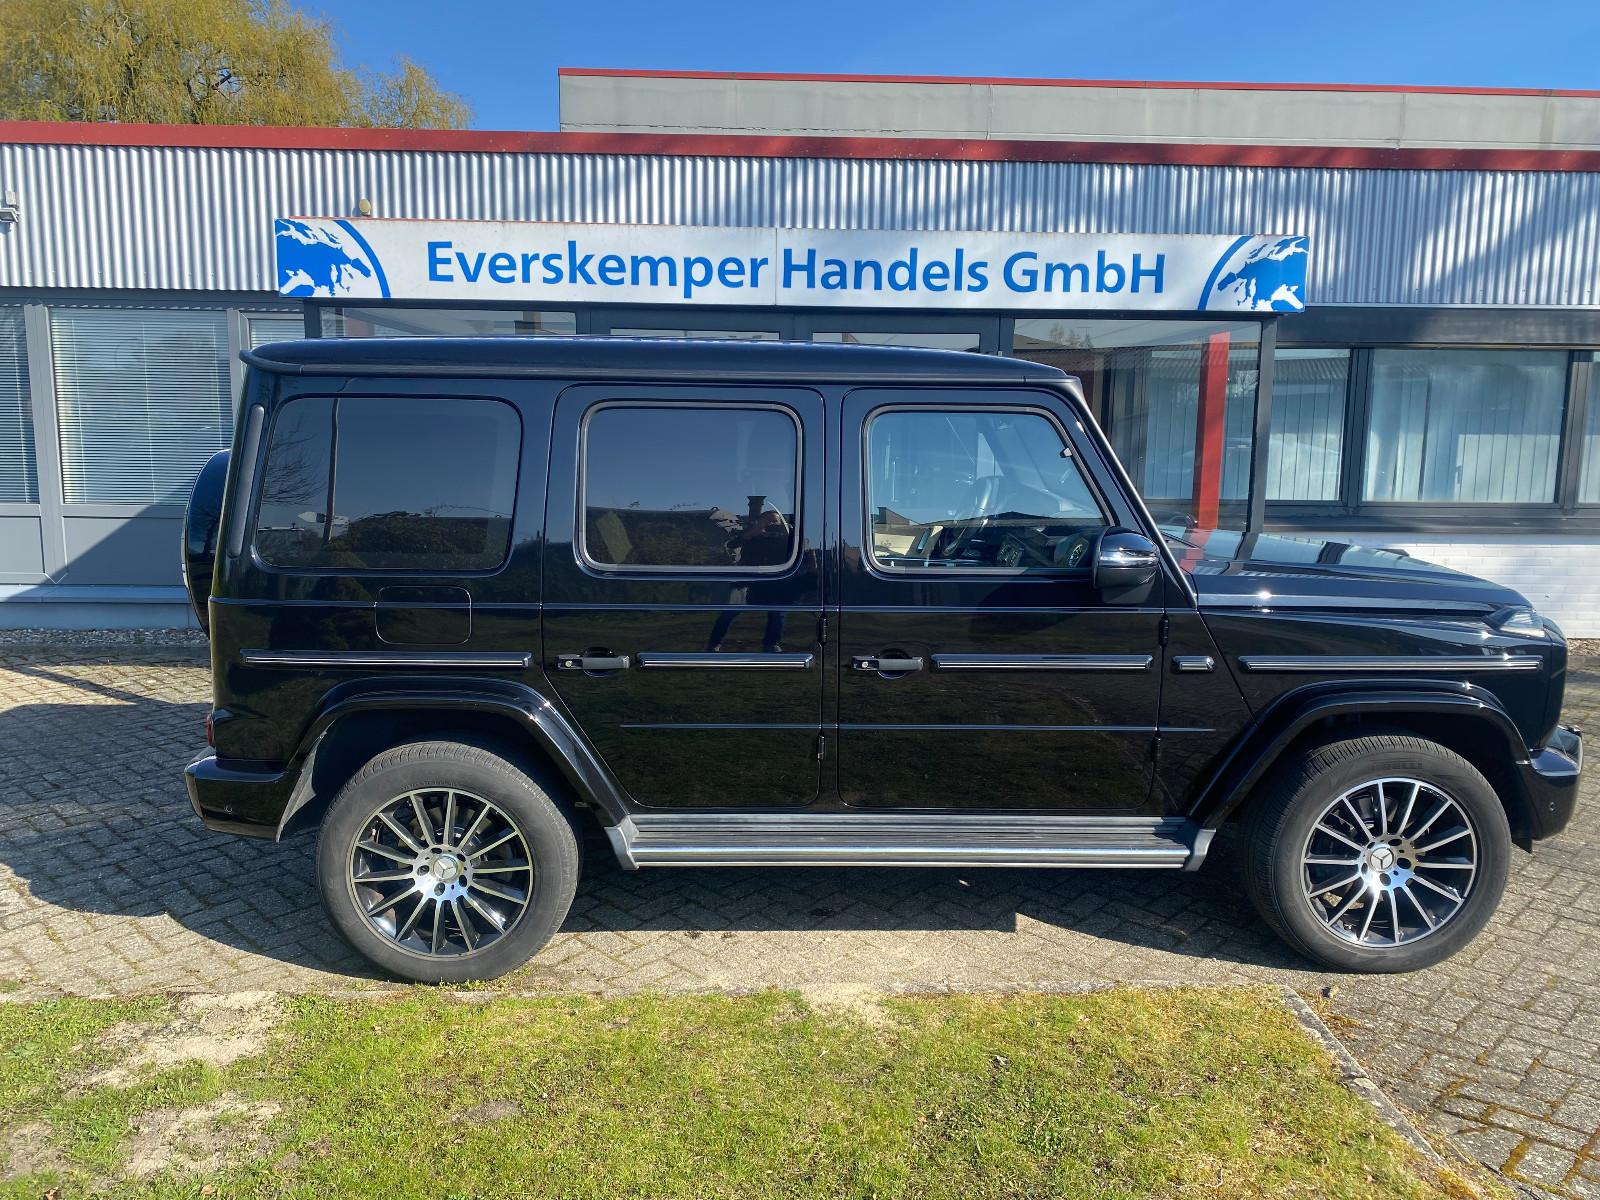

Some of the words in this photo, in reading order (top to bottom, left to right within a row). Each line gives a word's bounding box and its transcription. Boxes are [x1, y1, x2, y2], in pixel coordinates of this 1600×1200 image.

[427, 240, 769, 299] Everskemper
[783, 248, 989, 294] Handels
[1004, 251, 1165, 294] GmbH
